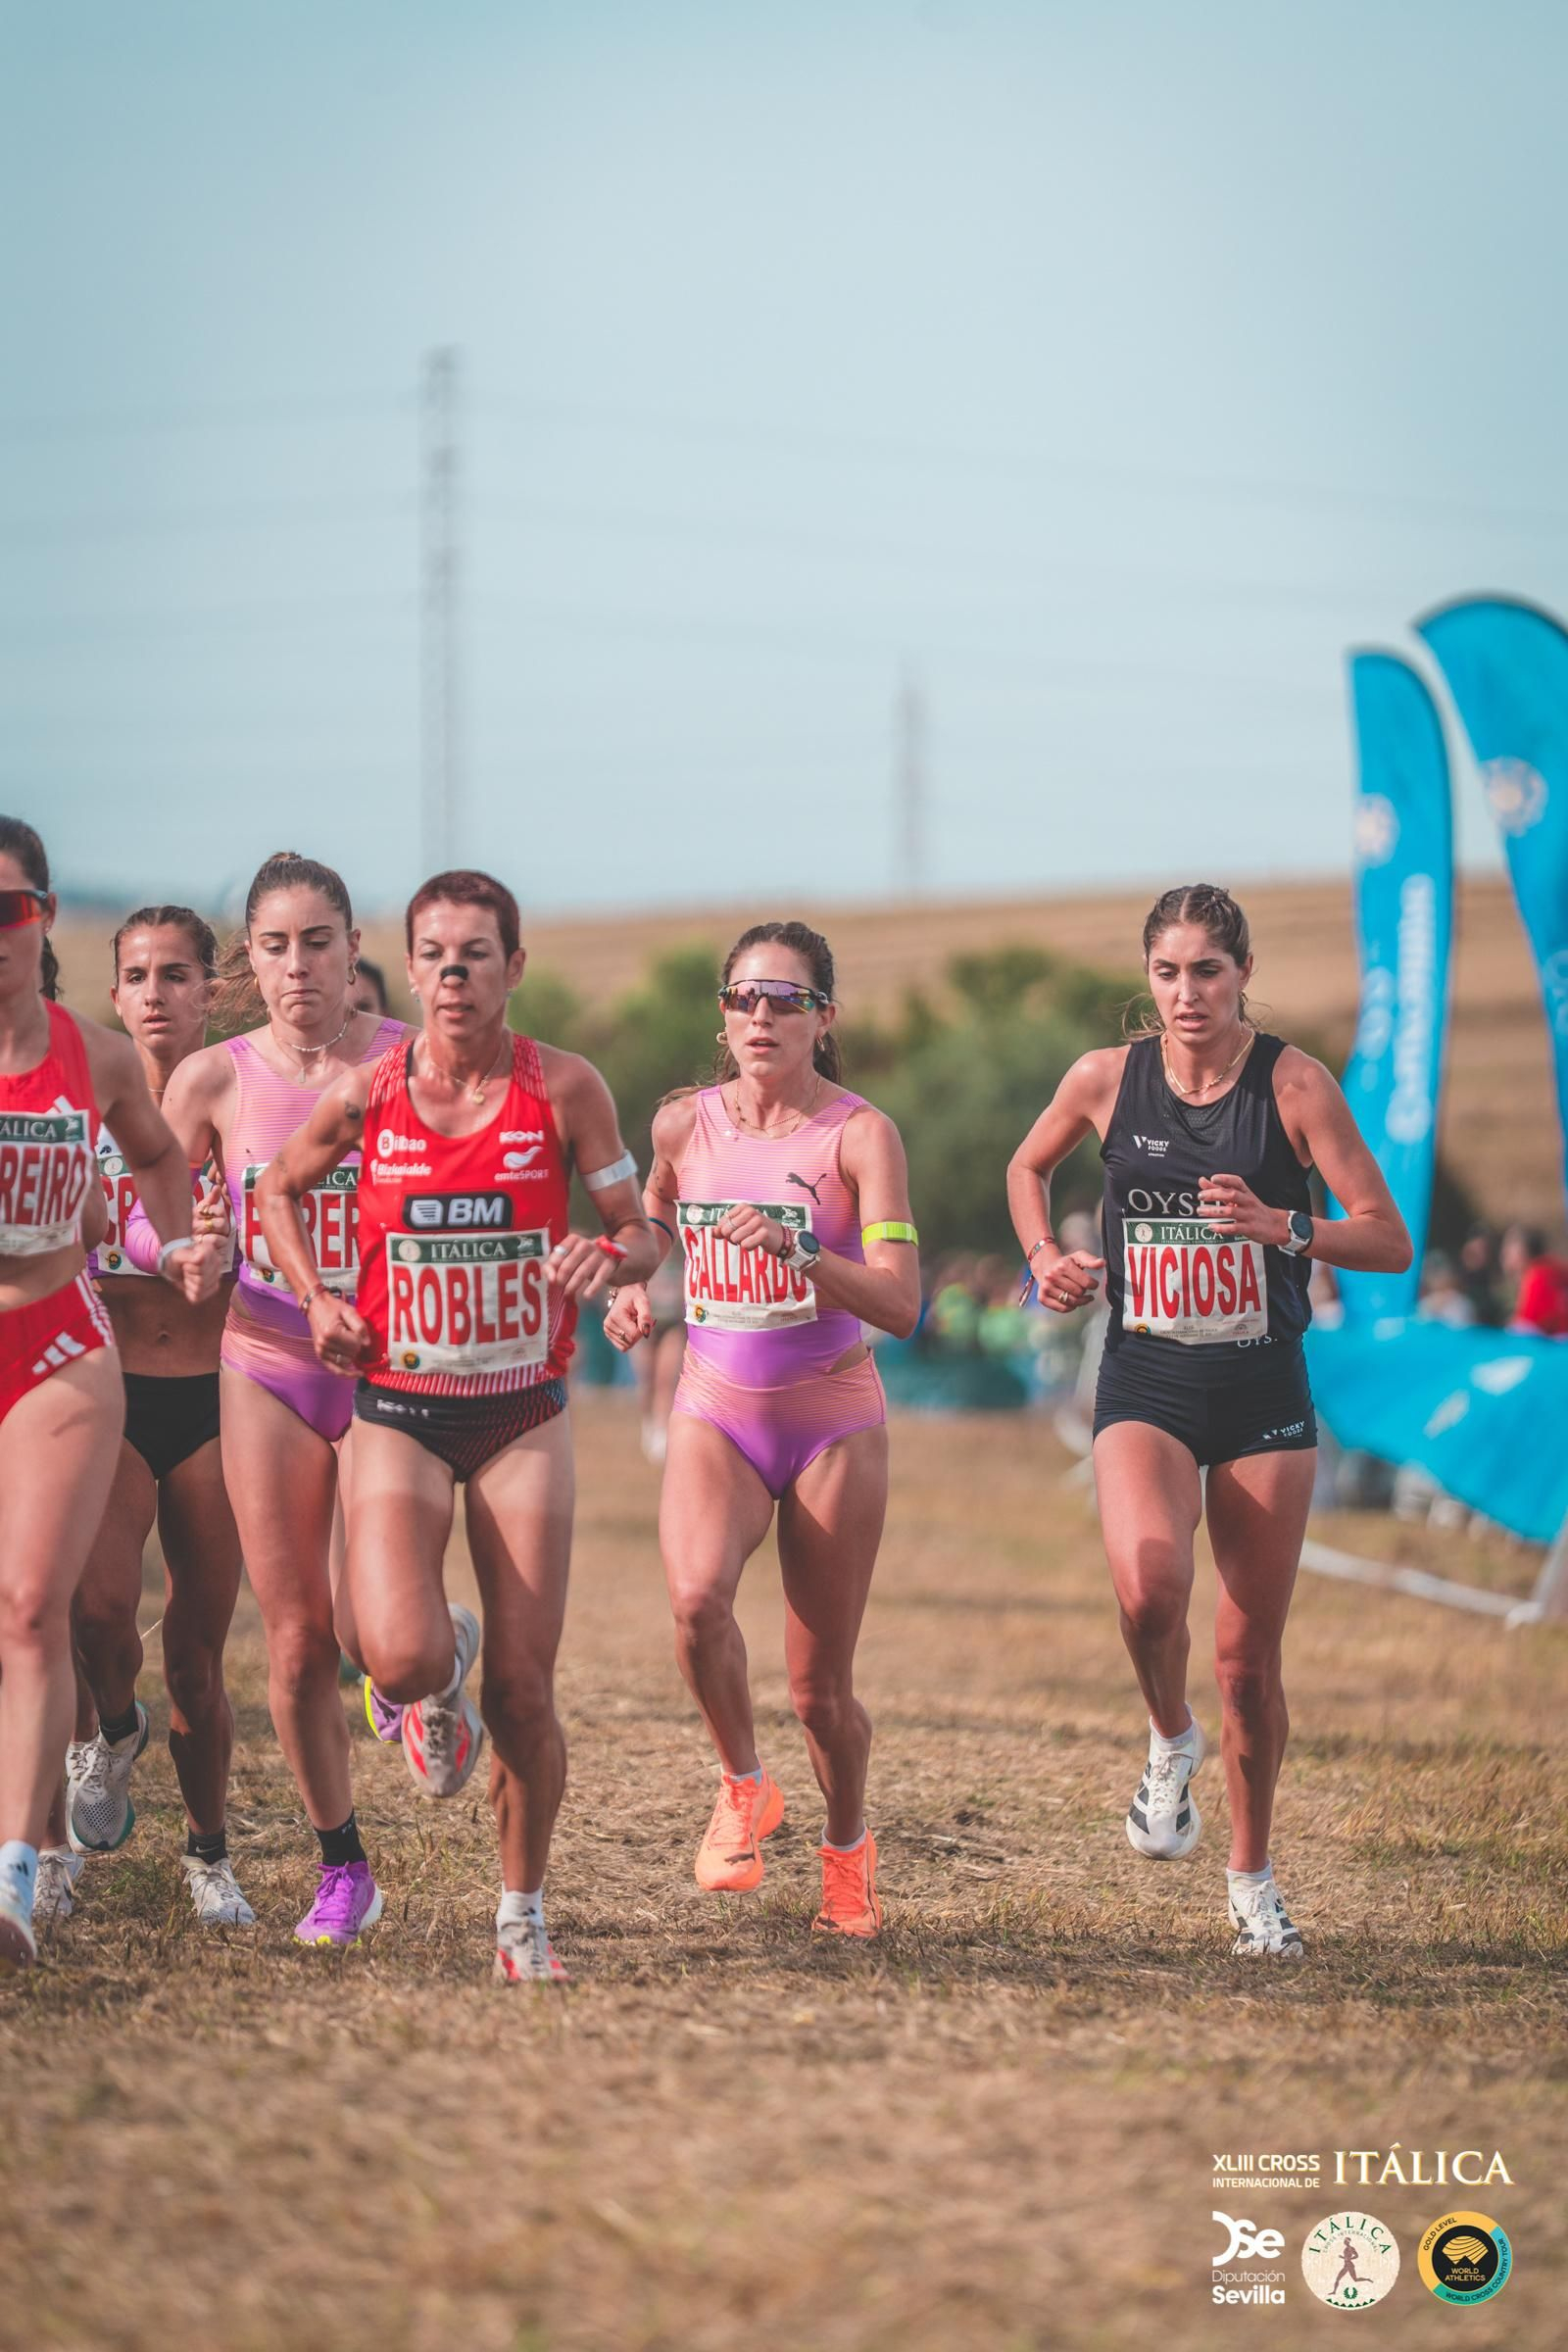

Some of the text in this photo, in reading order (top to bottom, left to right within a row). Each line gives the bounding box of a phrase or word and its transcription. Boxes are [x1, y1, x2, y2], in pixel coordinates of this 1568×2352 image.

[0, 1116, 57, 1138] ÁLICA
[380, 1133, 427, 1154] Bilbao
[447, 1197, 505, 1225] BM
[1128, 1189, 1220, 1216] OYS
[431, 1240, 507, 1259] ITÁLICA
[1128, 1244, 1261, 1319] VICIOSA
[392, 1258, 542, 1346] ROBLES
